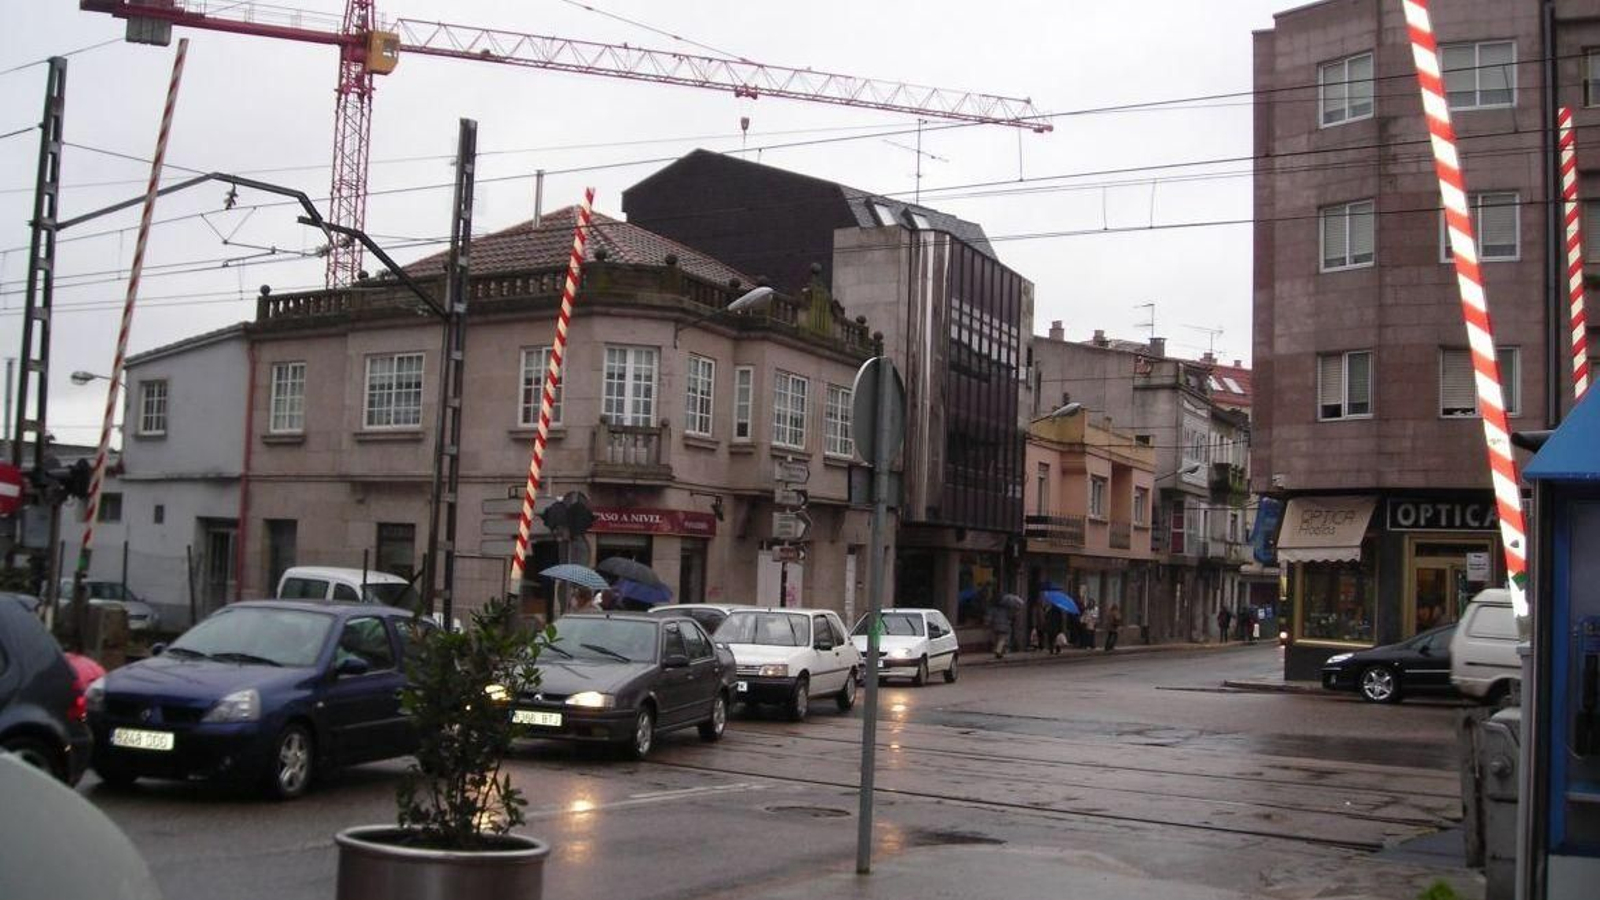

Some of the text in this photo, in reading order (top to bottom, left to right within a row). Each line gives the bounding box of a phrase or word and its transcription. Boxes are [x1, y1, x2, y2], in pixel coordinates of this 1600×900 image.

[620, 513, 628, 522] A
[630, 514, 663, 524] NIVEL
[1301, 510, 1357, 526] OPTICA
[1397, 503, 1497, 527] OPTICA
